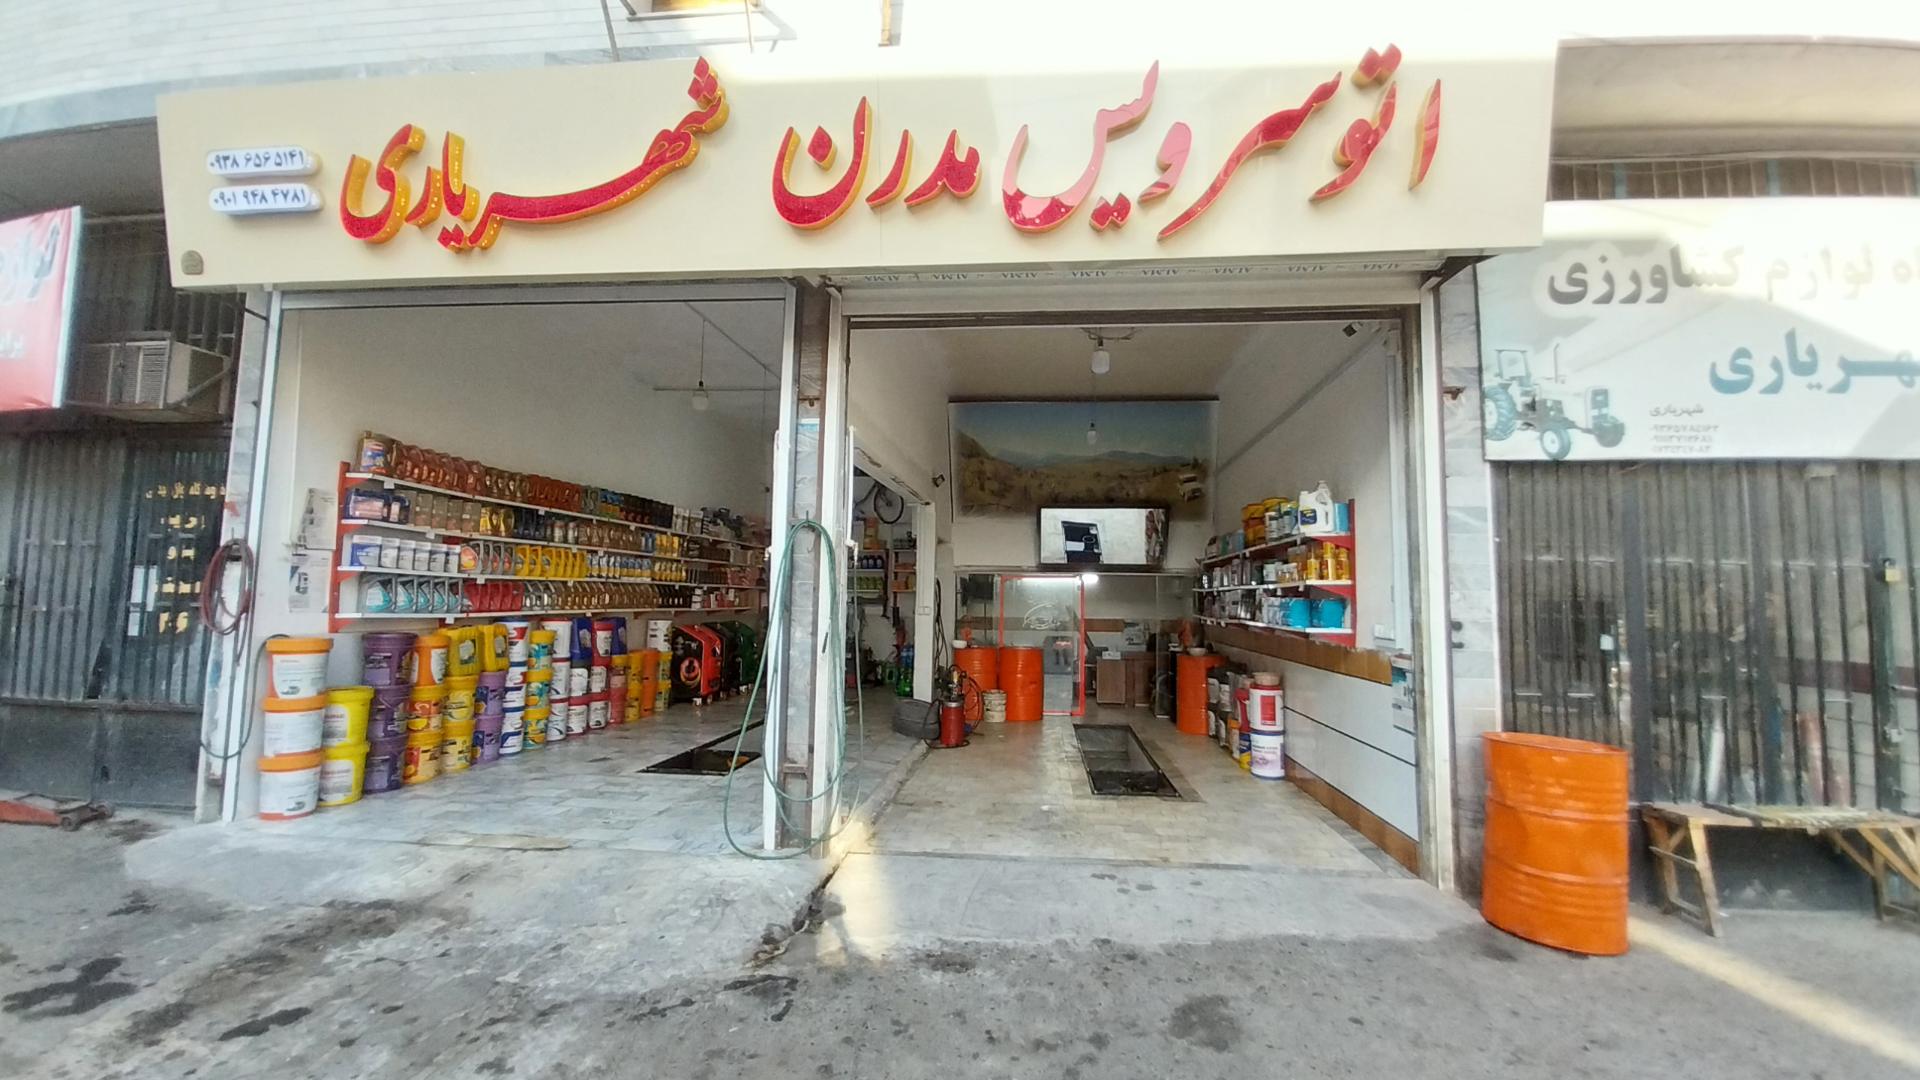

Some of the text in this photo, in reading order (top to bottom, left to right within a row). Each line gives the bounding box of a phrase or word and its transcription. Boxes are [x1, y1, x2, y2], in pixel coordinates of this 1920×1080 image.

[210, 149, 304, 170] ۰۹۳۸ ۶۵۶ ۵۱۴۱
[340, 56, 730, 253] شهریاری
[771, 95, 981, 230] مدرن
[213, 187, 306, 206] ۰۹۰۱ ۹۴۸ ۴۷۸۱
[1548, 244, 1744, 305] کشاورزی
[1766, 241, 1874, 302] لوازم
[1709, 328, 1920, 396] هریاری
